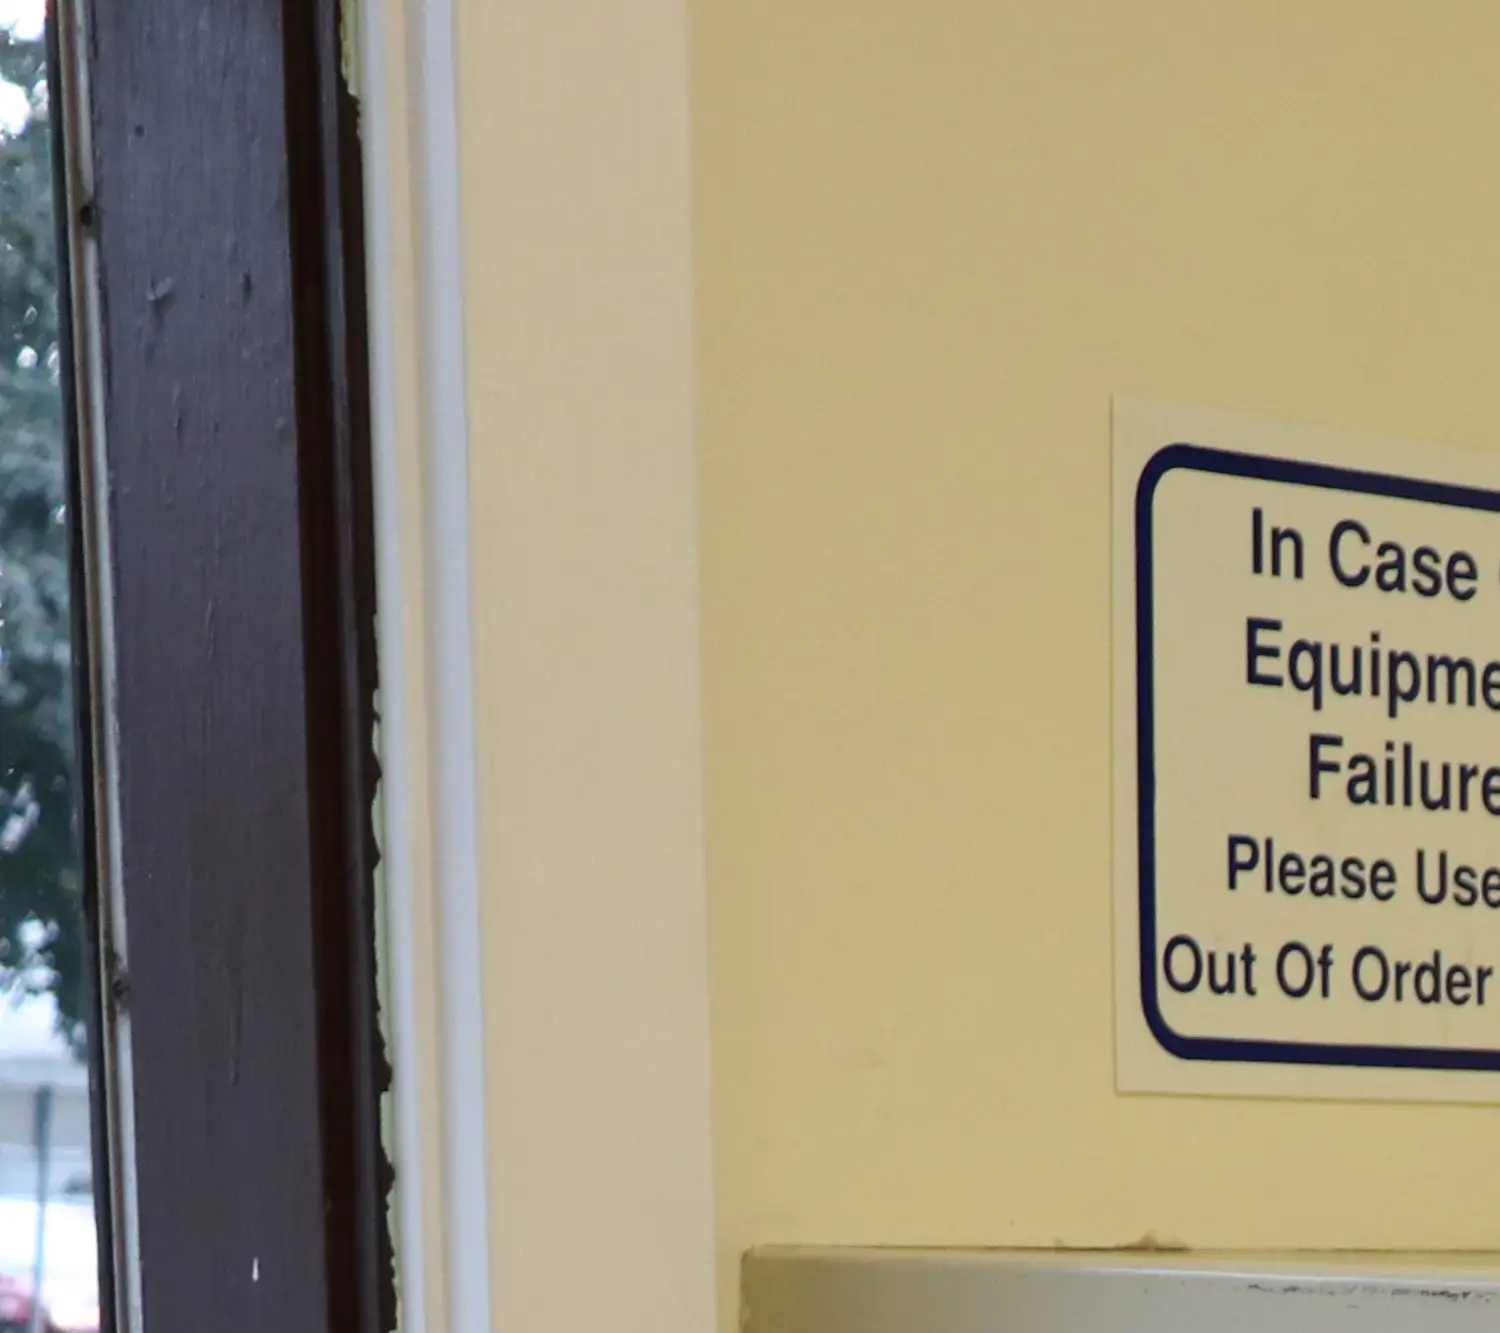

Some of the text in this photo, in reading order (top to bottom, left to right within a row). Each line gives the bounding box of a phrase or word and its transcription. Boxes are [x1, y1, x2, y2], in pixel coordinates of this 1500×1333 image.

[1252, 507, 1305, 580] In
[1329, 518, 1479, 602] Case
[1227, 833, 1397, 902] Please
[1162, 933, 1258, 997] Out
[1276, 941, 1334, 999] Of
[1351, 945, 1494, 1006] Order
